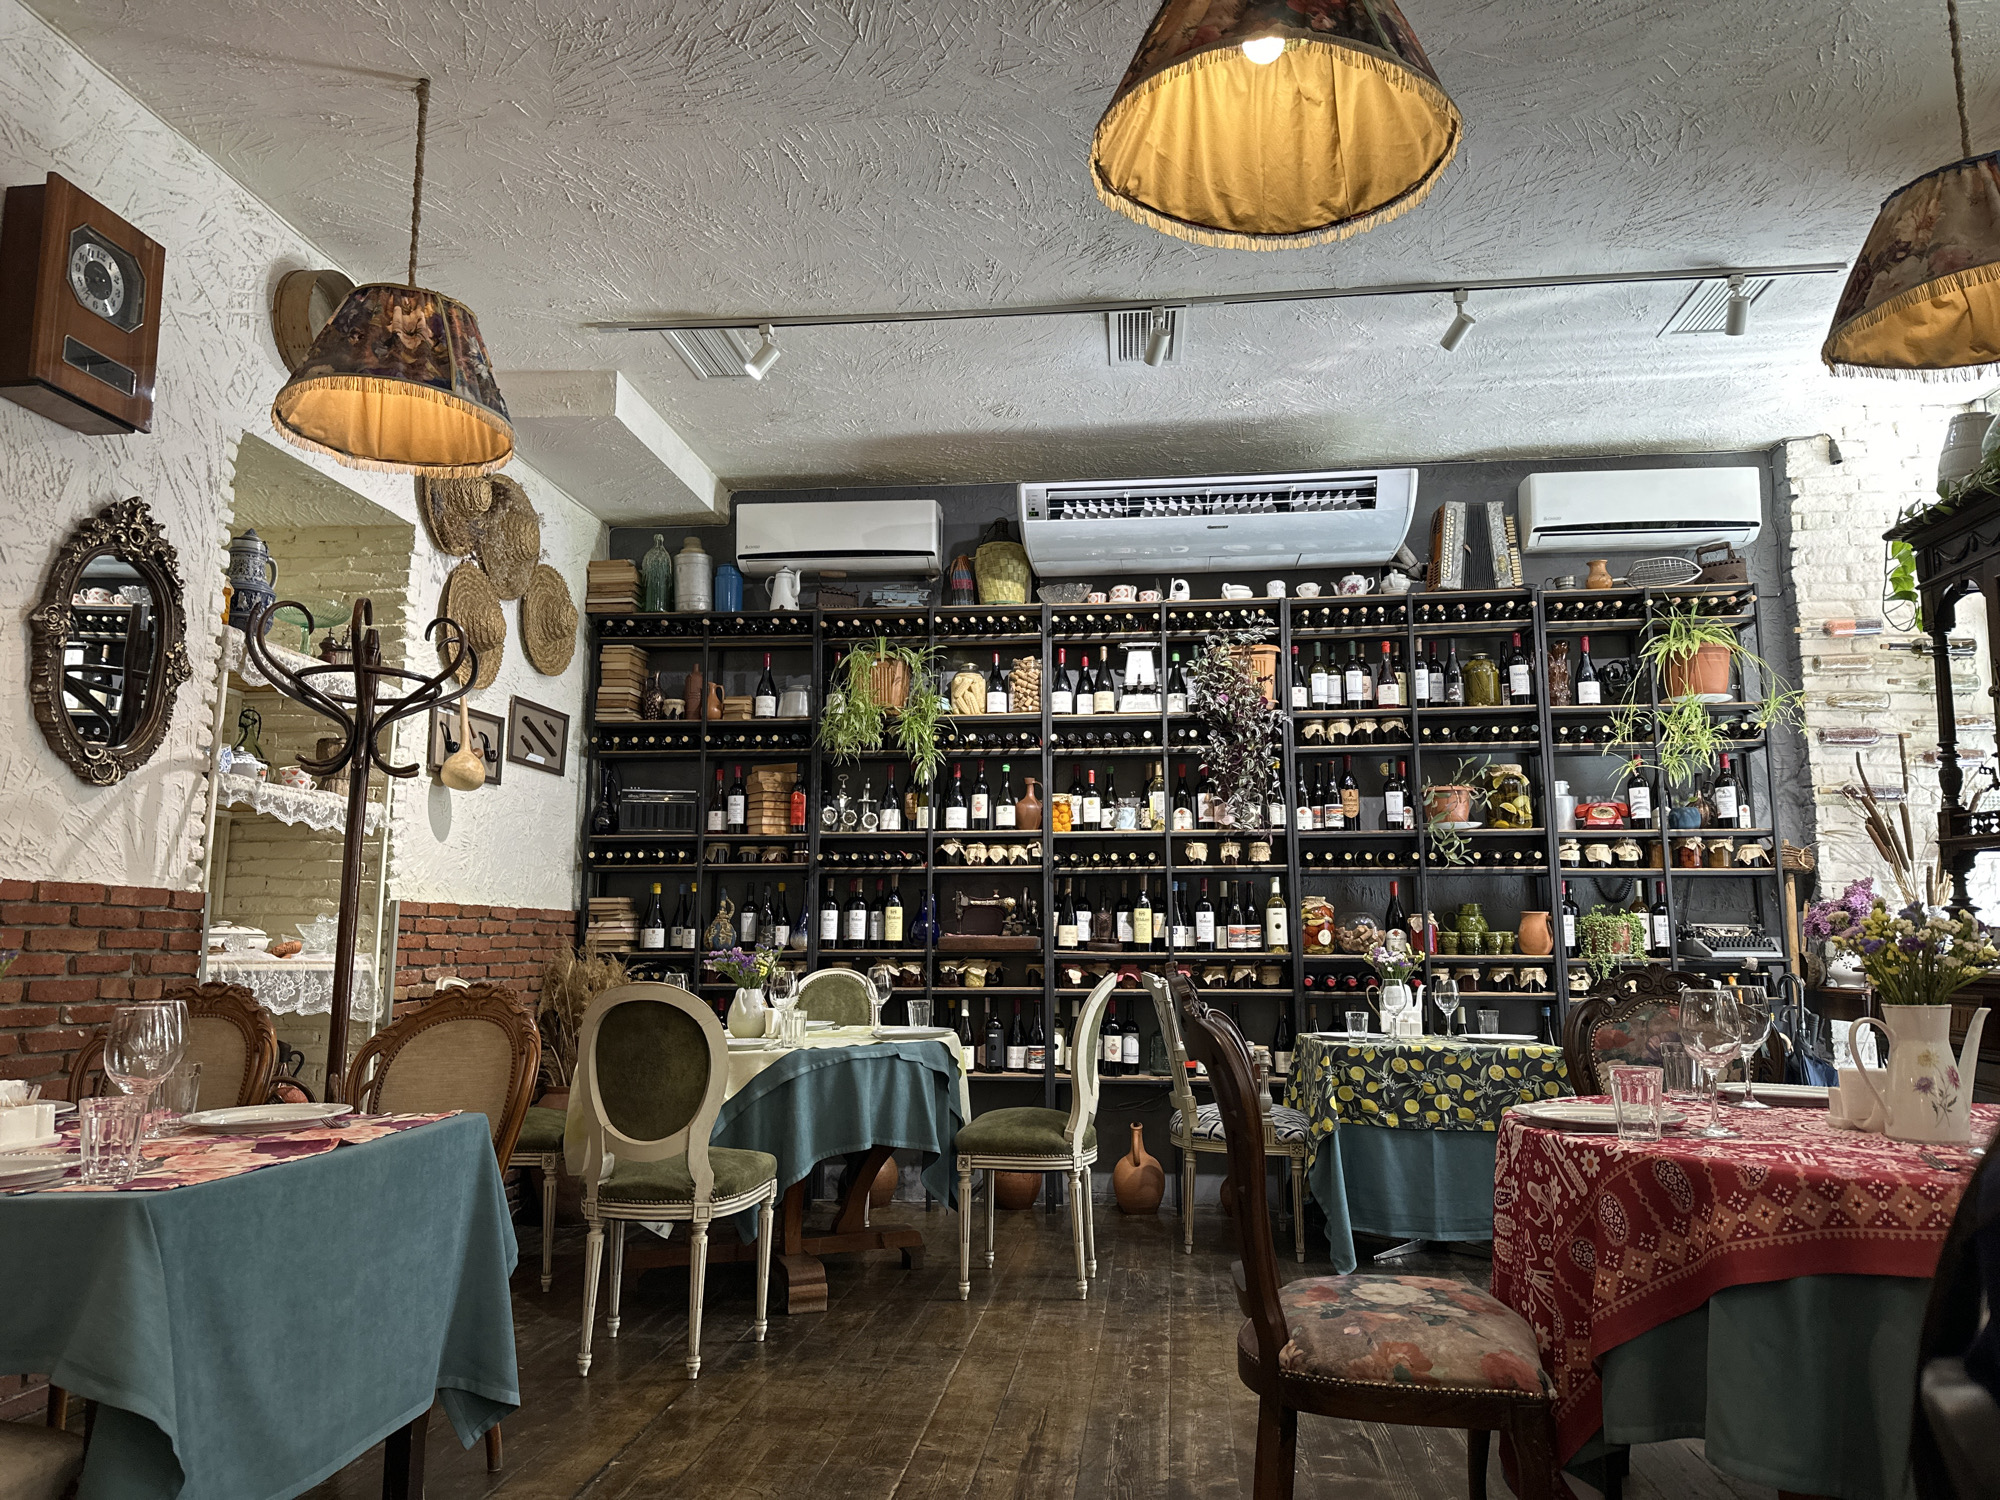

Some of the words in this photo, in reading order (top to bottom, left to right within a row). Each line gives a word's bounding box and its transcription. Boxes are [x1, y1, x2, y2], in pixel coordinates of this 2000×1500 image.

[78, 252, 88, 263] 10
[97, 250, 106, 262] 12
[75, 263, 81, 272] 9
[113, 275, 120, 285] 2
